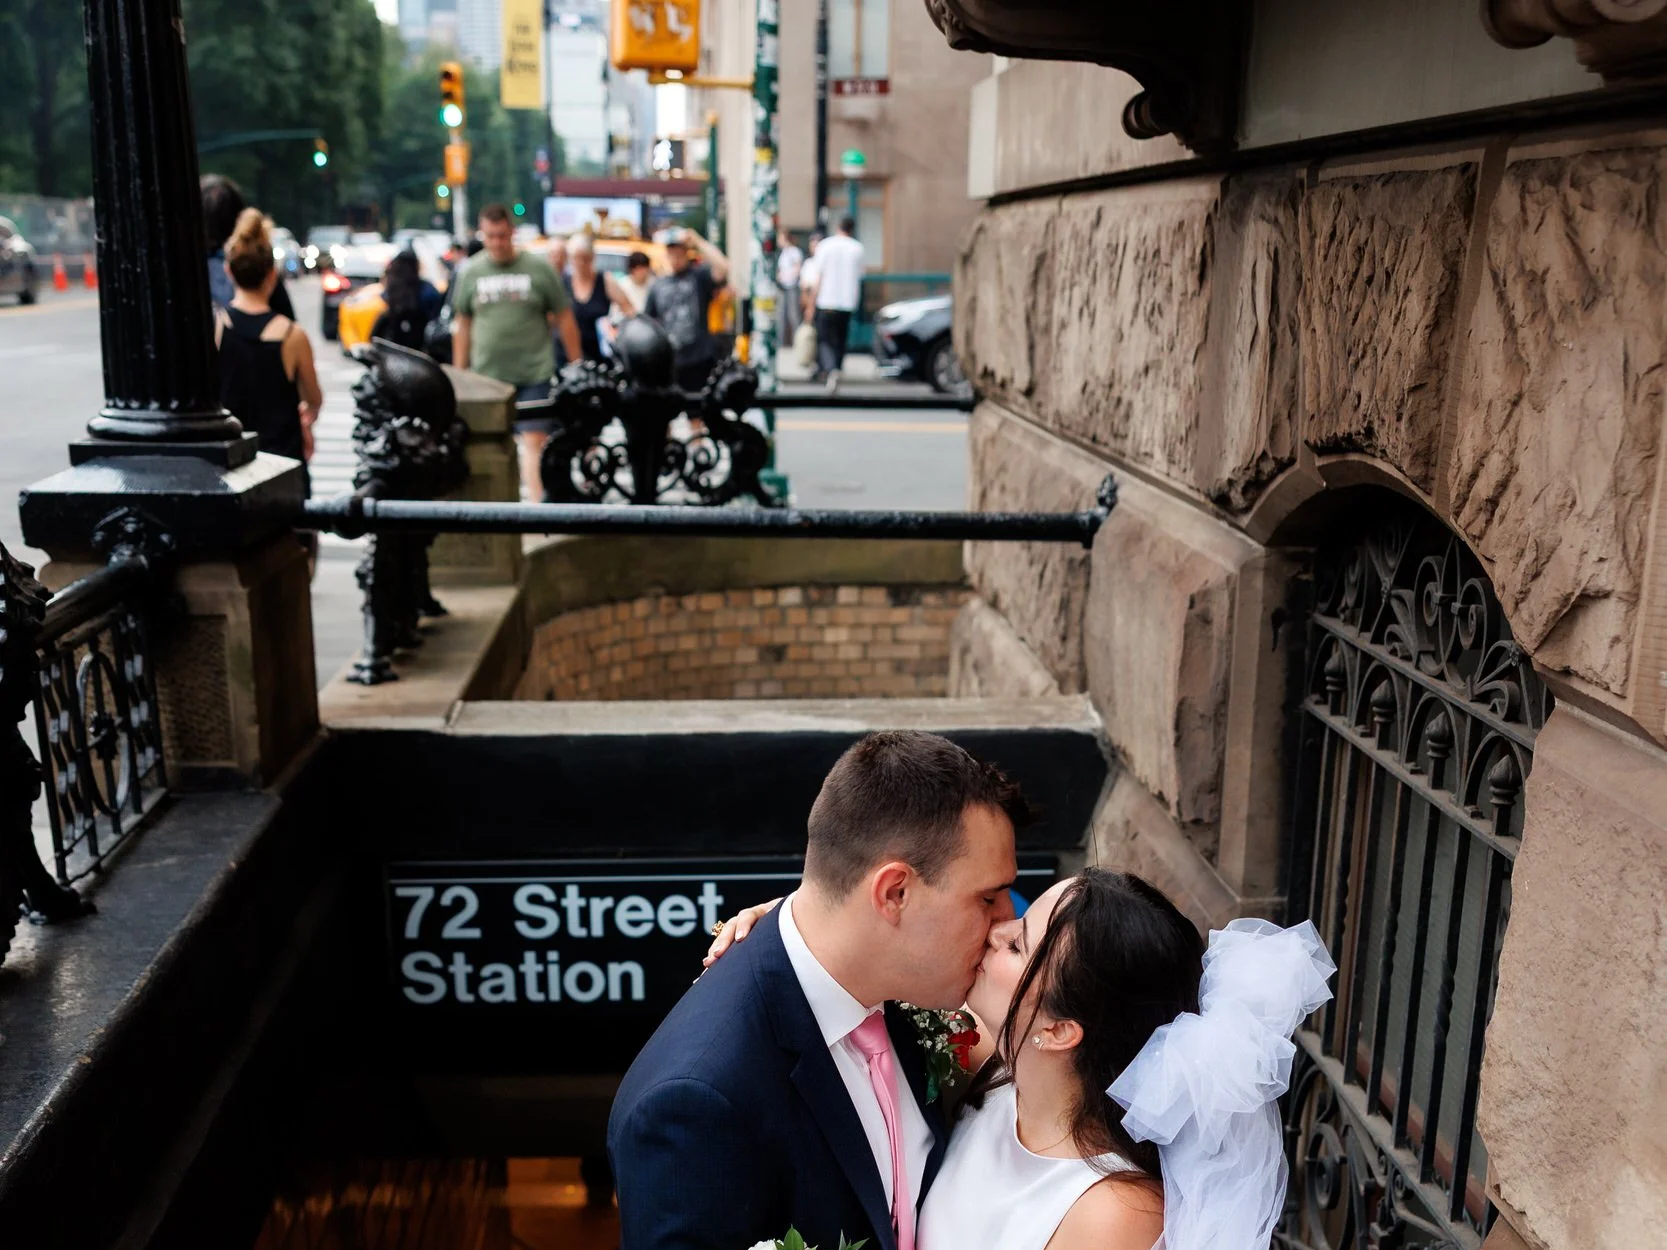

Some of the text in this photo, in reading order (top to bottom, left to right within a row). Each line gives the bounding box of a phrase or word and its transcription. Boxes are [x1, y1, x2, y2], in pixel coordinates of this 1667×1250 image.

[395, 882, 724, 939] 72 Street
[401, 951, 645, 1003] Station
